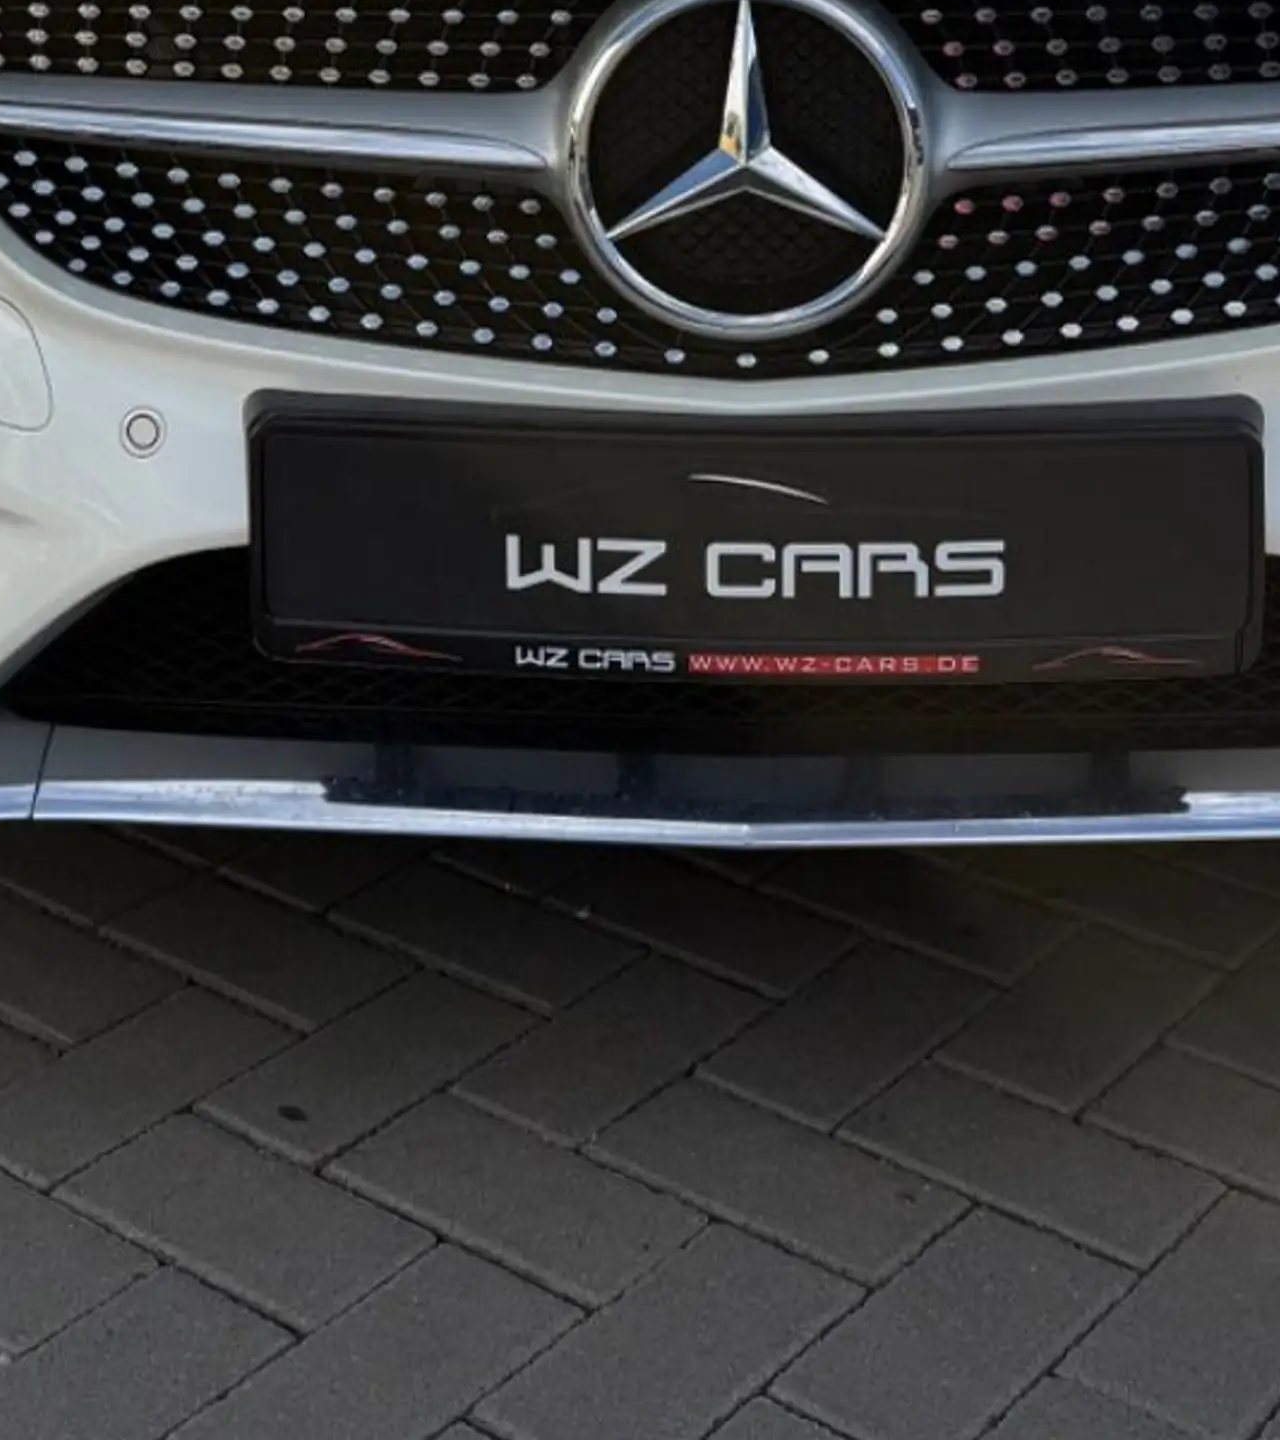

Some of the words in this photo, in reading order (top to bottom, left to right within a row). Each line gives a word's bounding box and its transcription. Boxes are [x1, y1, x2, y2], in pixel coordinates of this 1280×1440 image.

[506, 534, 667, 596] WZ
[706, 540, 1006, 598] CARS
[515, 646, 570, 668] WZ
[578, 648, 676, 673] CARS
[689, 654, 981, 674] WWW.WZ-CARS.DE
